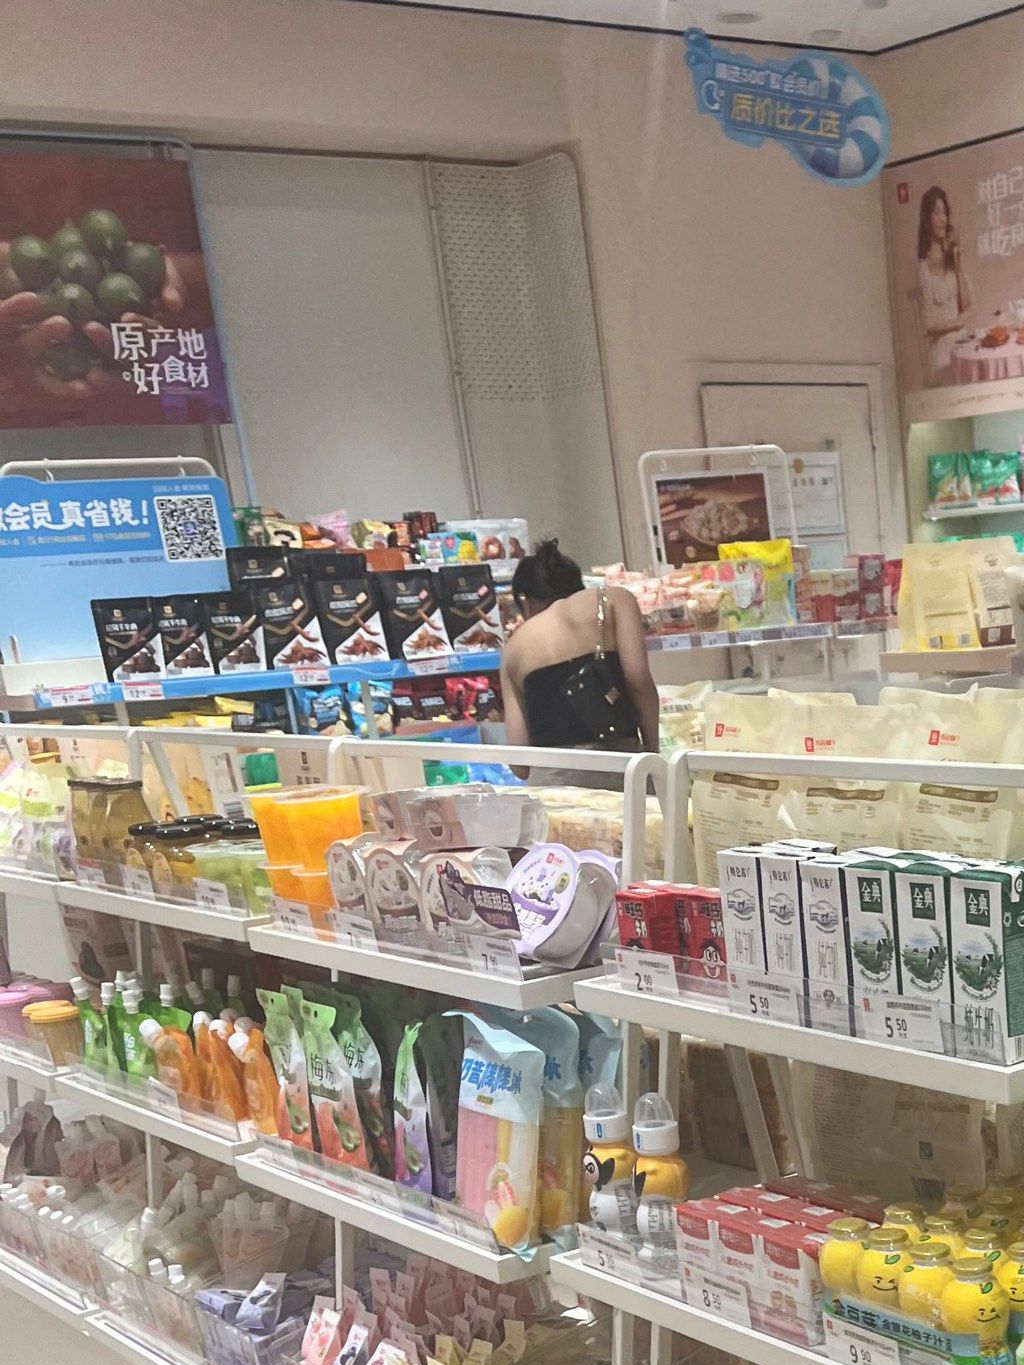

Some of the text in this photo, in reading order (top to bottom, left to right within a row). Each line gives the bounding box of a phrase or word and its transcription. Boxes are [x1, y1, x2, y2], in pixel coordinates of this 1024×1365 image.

[110, 322, 206, 360] 原产地
[133, 355, 209, 395] 好食材
[861, 880, 881, 904] 金典
[912, 886, 934, 910] 金典
[966, 892, 990, 917] 金典
[481, 953, 489, 970] 7
[635, 972, 643, 991] 2
[750, 994, 769, 1014] 5 50
[884, 1016, 908, 1038] 5 50
[702, 1289, 711, 1307] 8
[849, 1344, 872, 1364] 9 90
